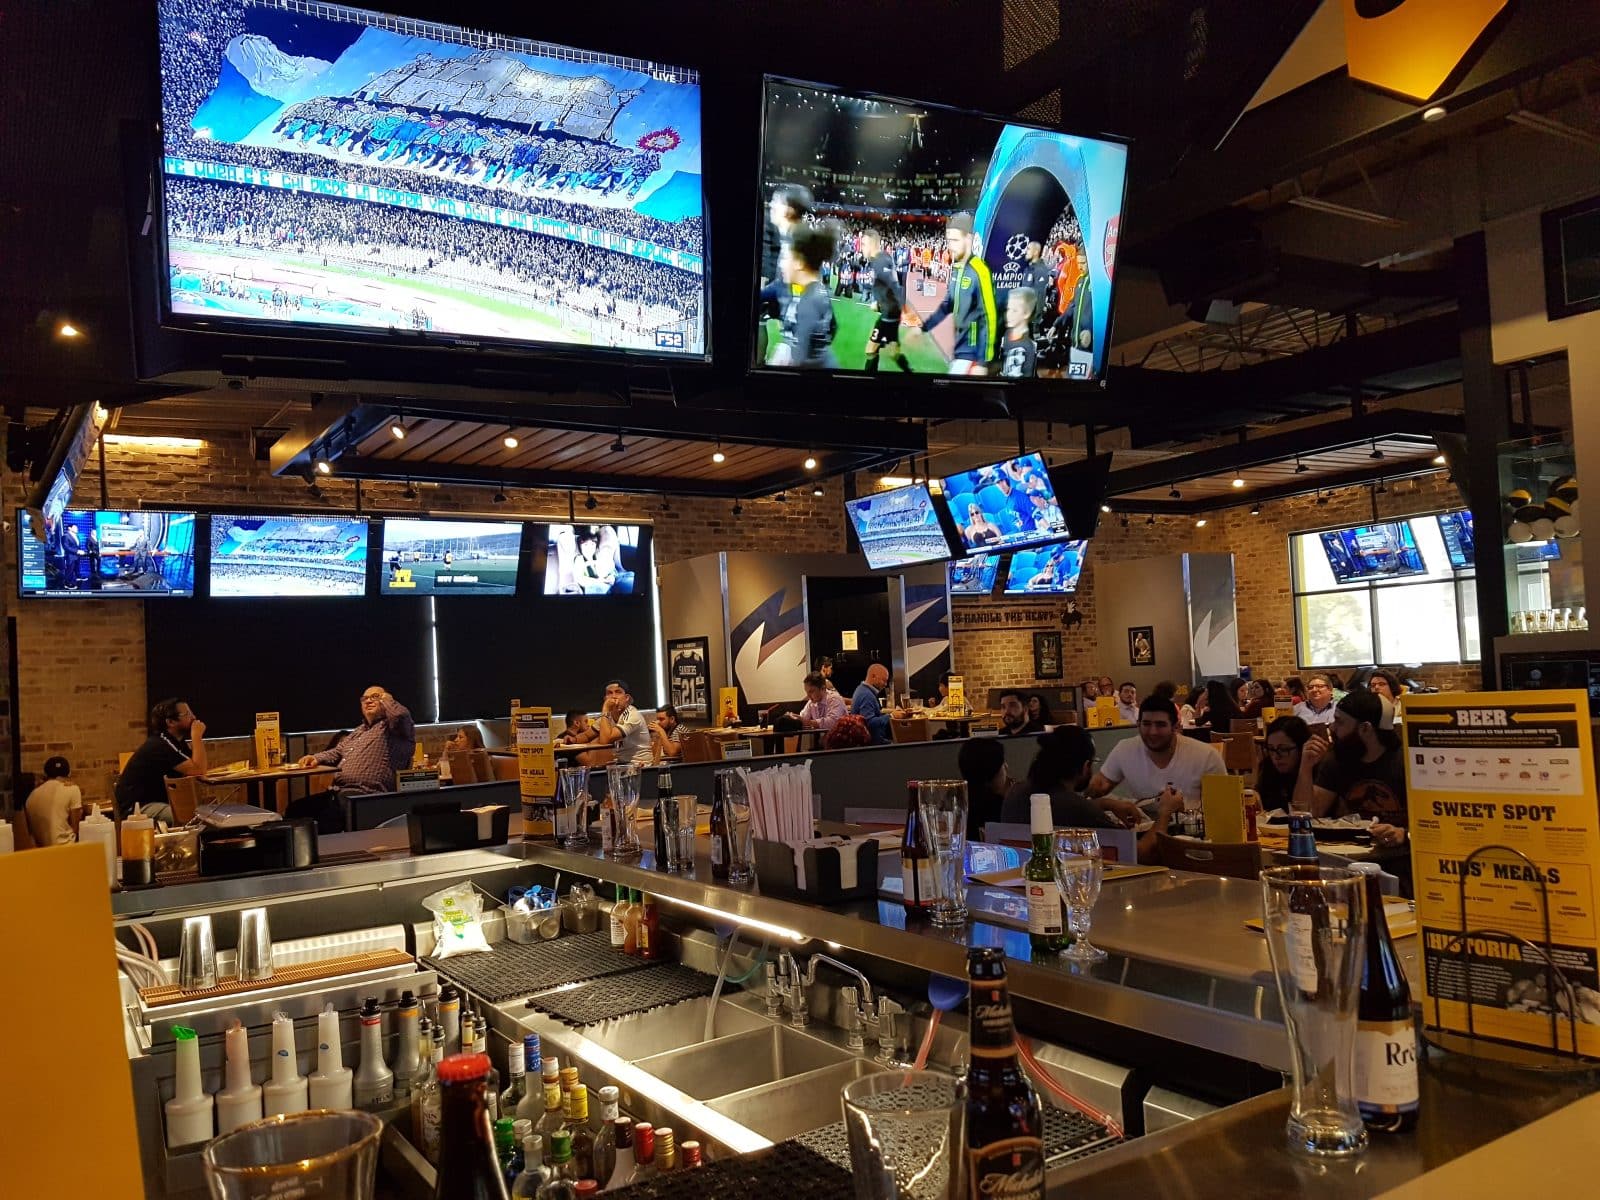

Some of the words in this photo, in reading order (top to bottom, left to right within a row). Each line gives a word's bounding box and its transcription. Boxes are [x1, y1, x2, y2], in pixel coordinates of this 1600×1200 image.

[652, 70, 676, 83] LIVE
[992, 272, 1025, 281] HAMPIO
[656, 331, 683, 347] FS2
[1068, 363, 1086, 375] FS1
[1004, 611, 1022, 622] THE
[681, 678, 696, 705] 21
[1456, 709, 1509, 726] BEER
[1432, 800, 1496, 820] SWEET
[1503, 804, 1556, 821] SPOT
[1493, 863, 1561, 884] MEALS
